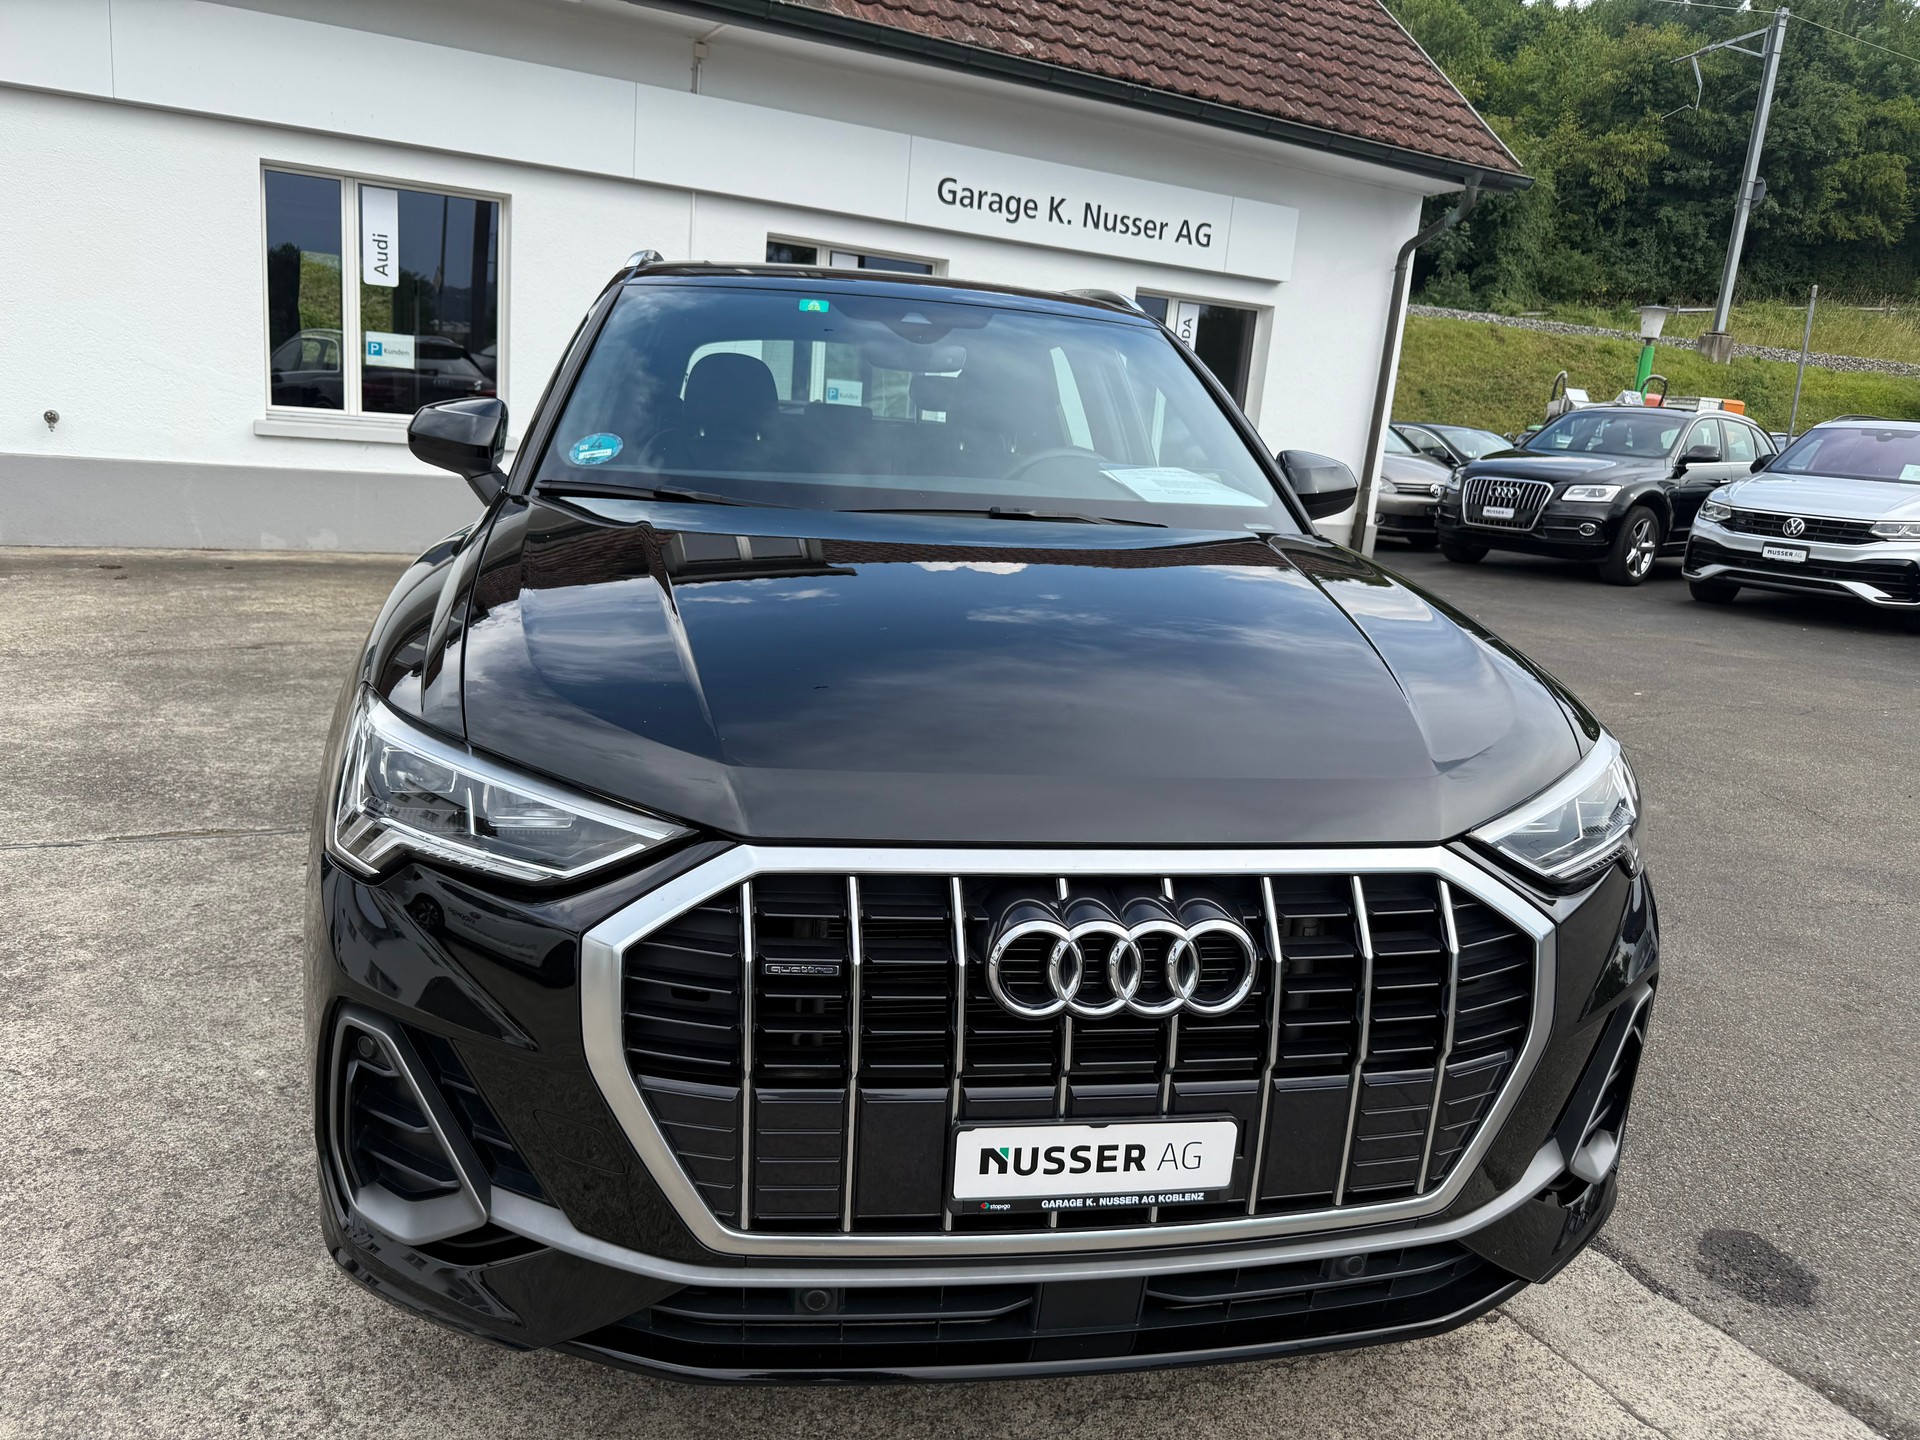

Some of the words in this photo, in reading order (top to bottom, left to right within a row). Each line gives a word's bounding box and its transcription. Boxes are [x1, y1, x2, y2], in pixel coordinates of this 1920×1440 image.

[937, 177, 1038, 224] Garage
[1048, 195, 1072, 225] K.
[1082, 202, 1168, 240] Nusser
[1174, 219, 1212, 248] AG
[372, 233, 389, 277] Audi
[384, 347, 410, 356] Kunden
[1767, 549, 1794, 557] NUSSER
[1794, 551, 1803, 559] AG
[770, 966, 834, 974] quattro
[979, 1143, 1147, 1176] NUSSER
[1157, 1141, 1203, 1171] AG
[1041, 1198, 1083, 1209] GARAGE
[1086, 1198, 1097, 1207] K.
[1099, 1195, 1140, 1206] NUSSER
[1141, 1195, 1156, 1204] AG
[1158, 1192, 1205, 1203] KOBLENZ
